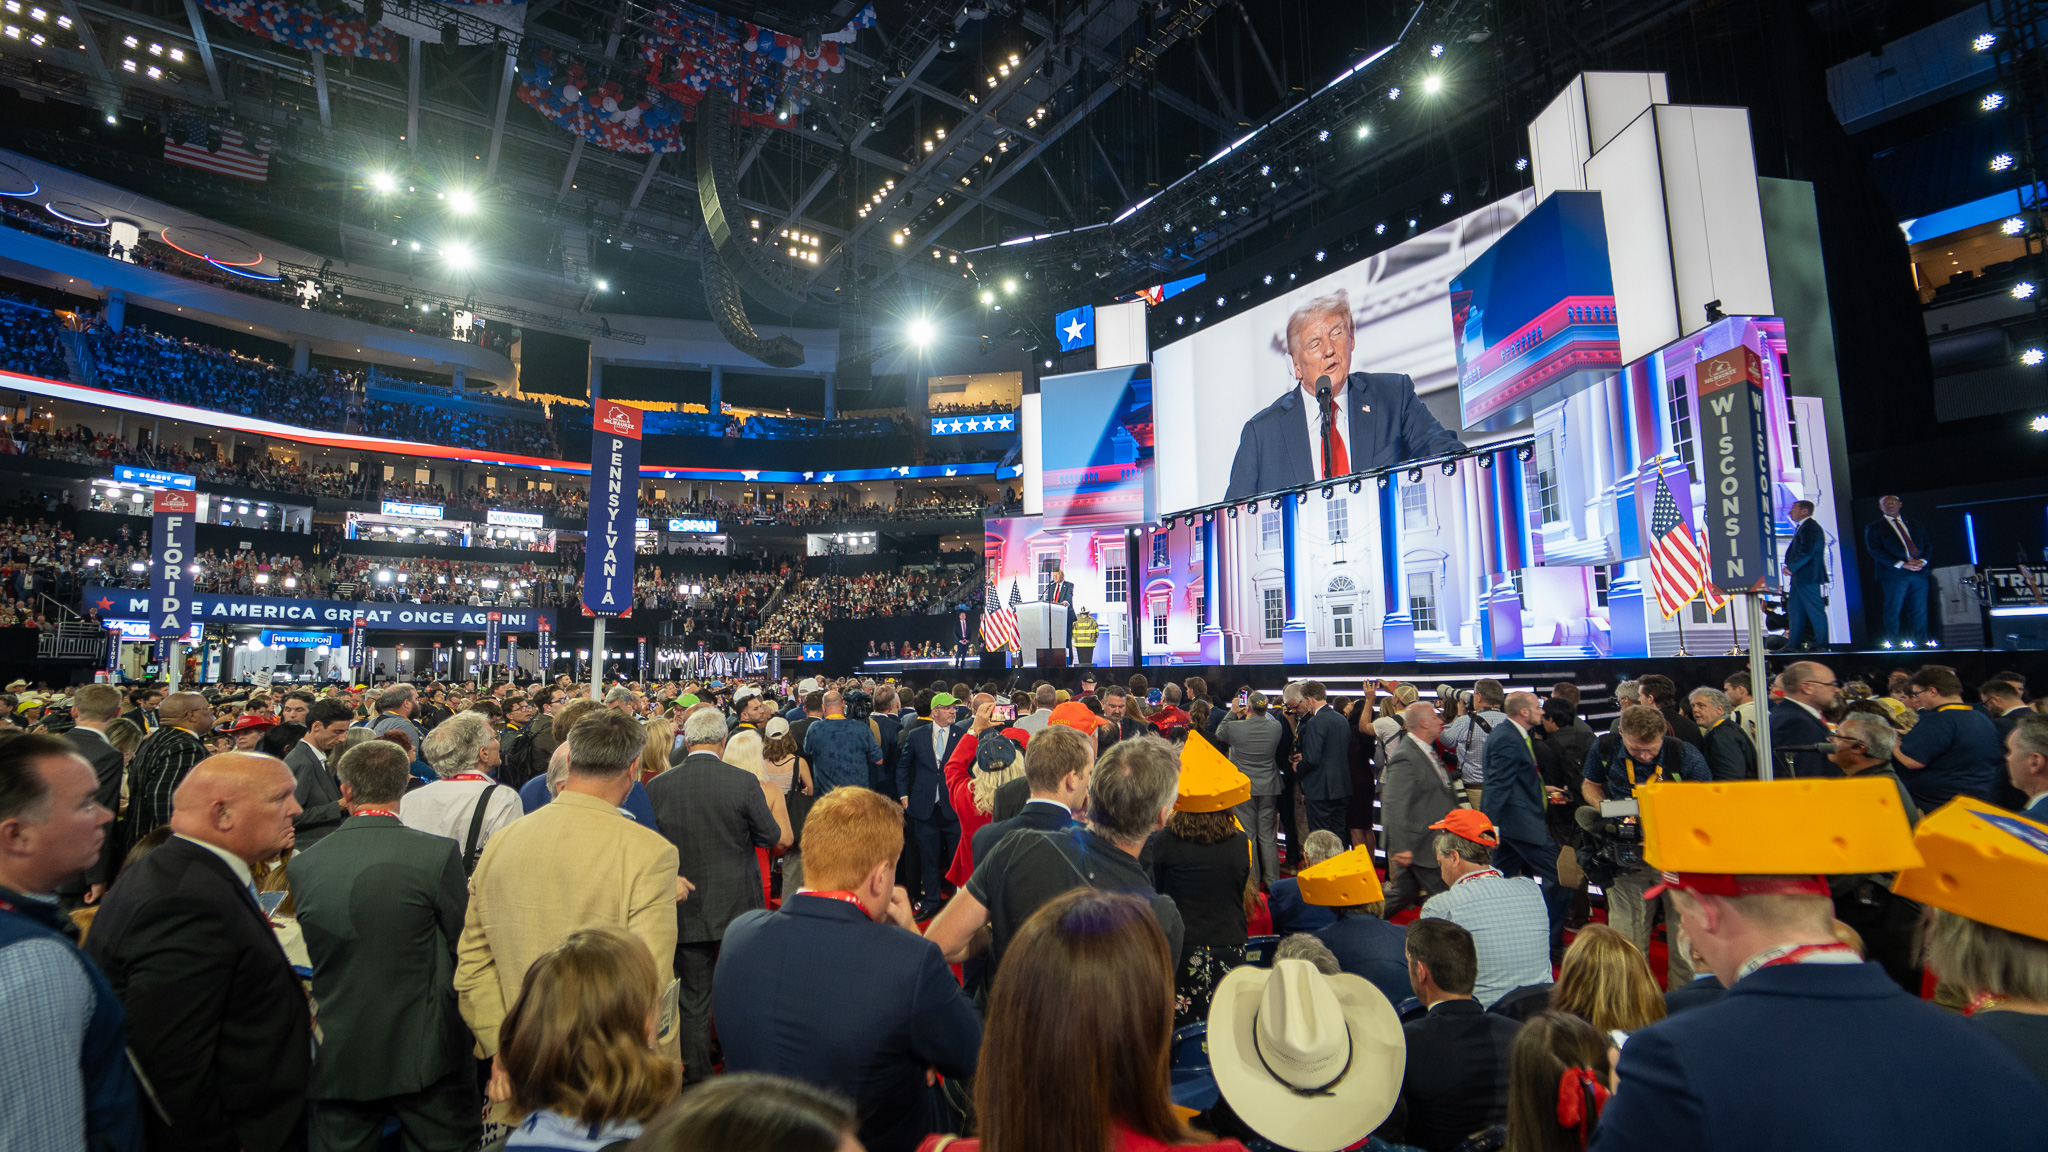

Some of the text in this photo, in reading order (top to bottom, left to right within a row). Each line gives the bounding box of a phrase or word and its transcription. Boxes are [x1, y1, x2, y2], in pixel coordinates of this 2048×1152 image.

[603, 418, 635, 430] MILWAUKEE
[1710, 393, 1745, 579] WISCONSIN
[1751, 391, 1776, 578] WISCONSIN
[412, 506, 441, 516] NEWS
[490, 514, 540, 525] NEWSMAX
[601, 438, 624, 605] PENNSYLVANIA
[669, 519, 717, 532] C-SPAN
[161, 516, 183, 629] FLORIDA
[129, 598, 527, 626] ME AMERICA GREAT ONCE AGIN!
[355, 628, 364, 663] TEXAS
